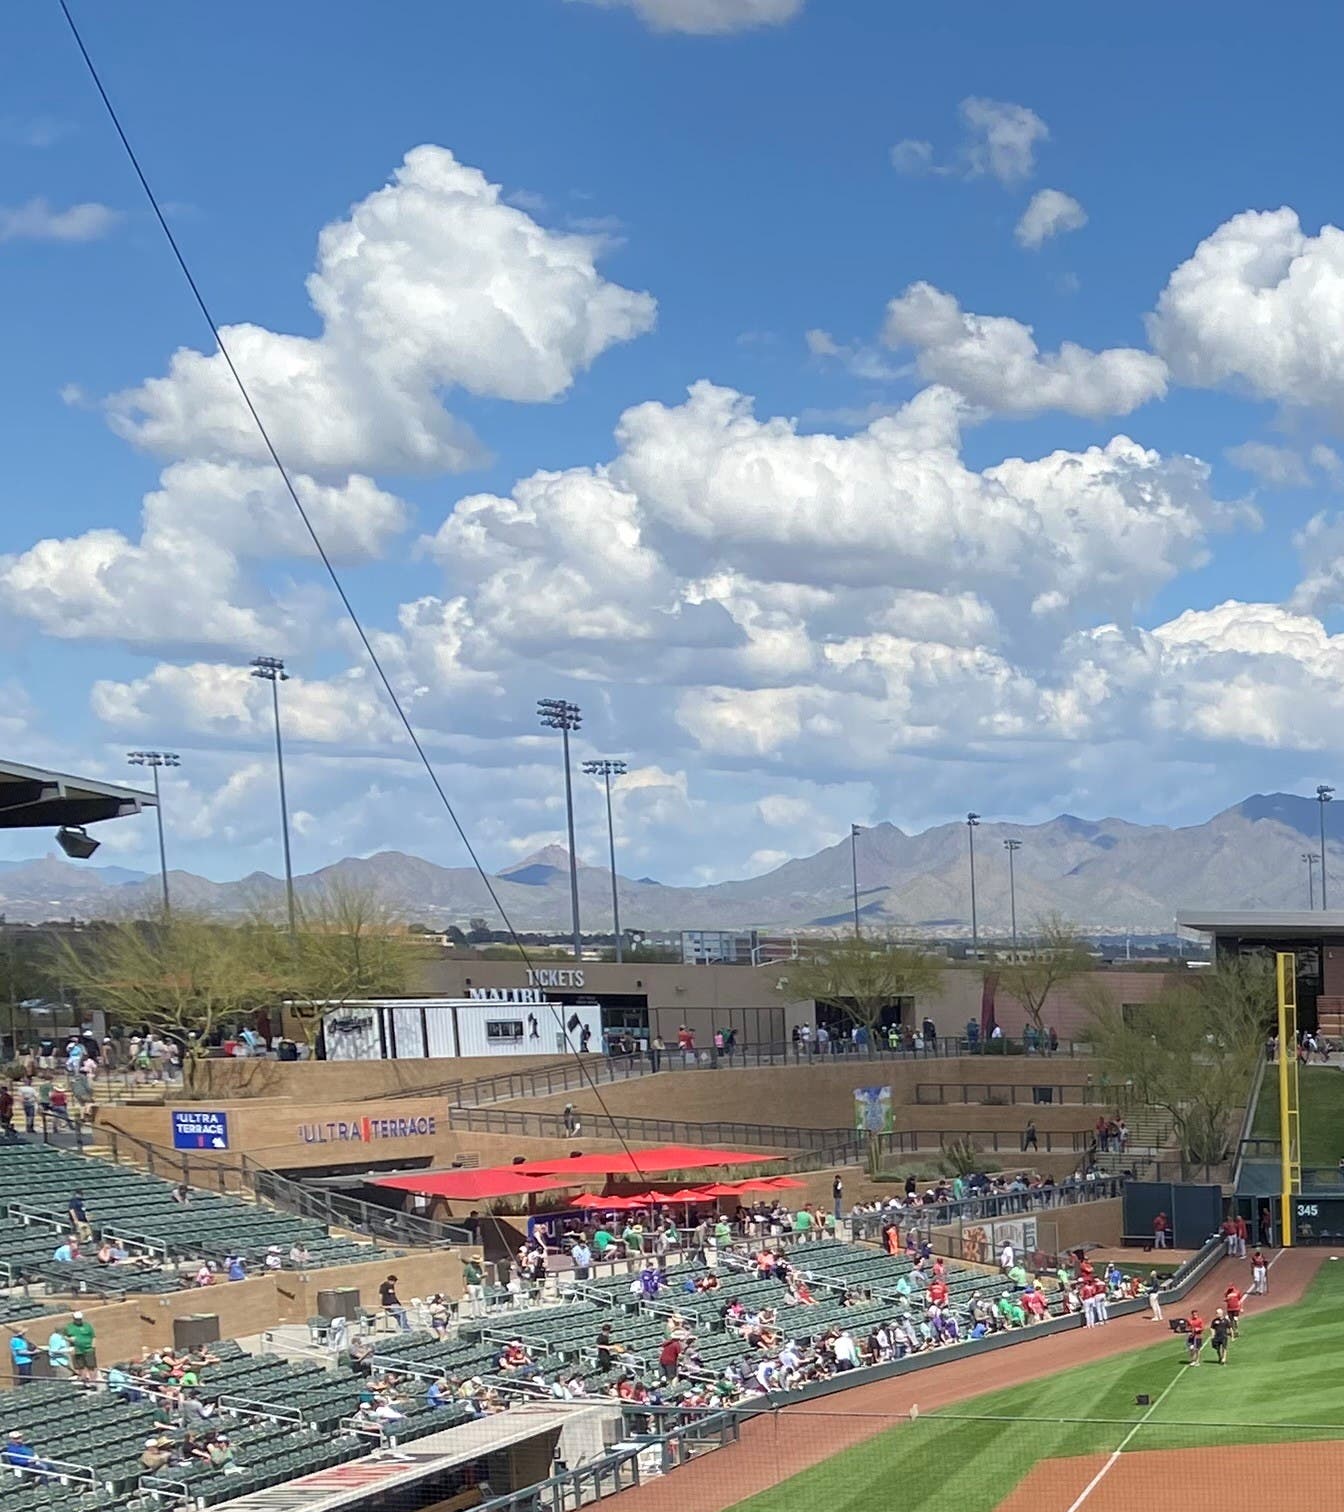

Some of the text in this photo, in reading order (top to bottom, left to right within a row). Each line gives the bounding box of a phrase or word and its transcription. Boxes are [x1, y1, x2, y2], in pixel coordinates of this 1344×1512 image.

[526, 969, 585, 988] TICKETS
[468, 988, 547, 1003] MALIBU
[178, 1114, 219, 1124] ULTRA
[176, 1123, 225, 1136] TERRACE
[302, 1116, 436, 1144] ULTRA TERRACE
[1297, 1204, 1319, 1217] 345
